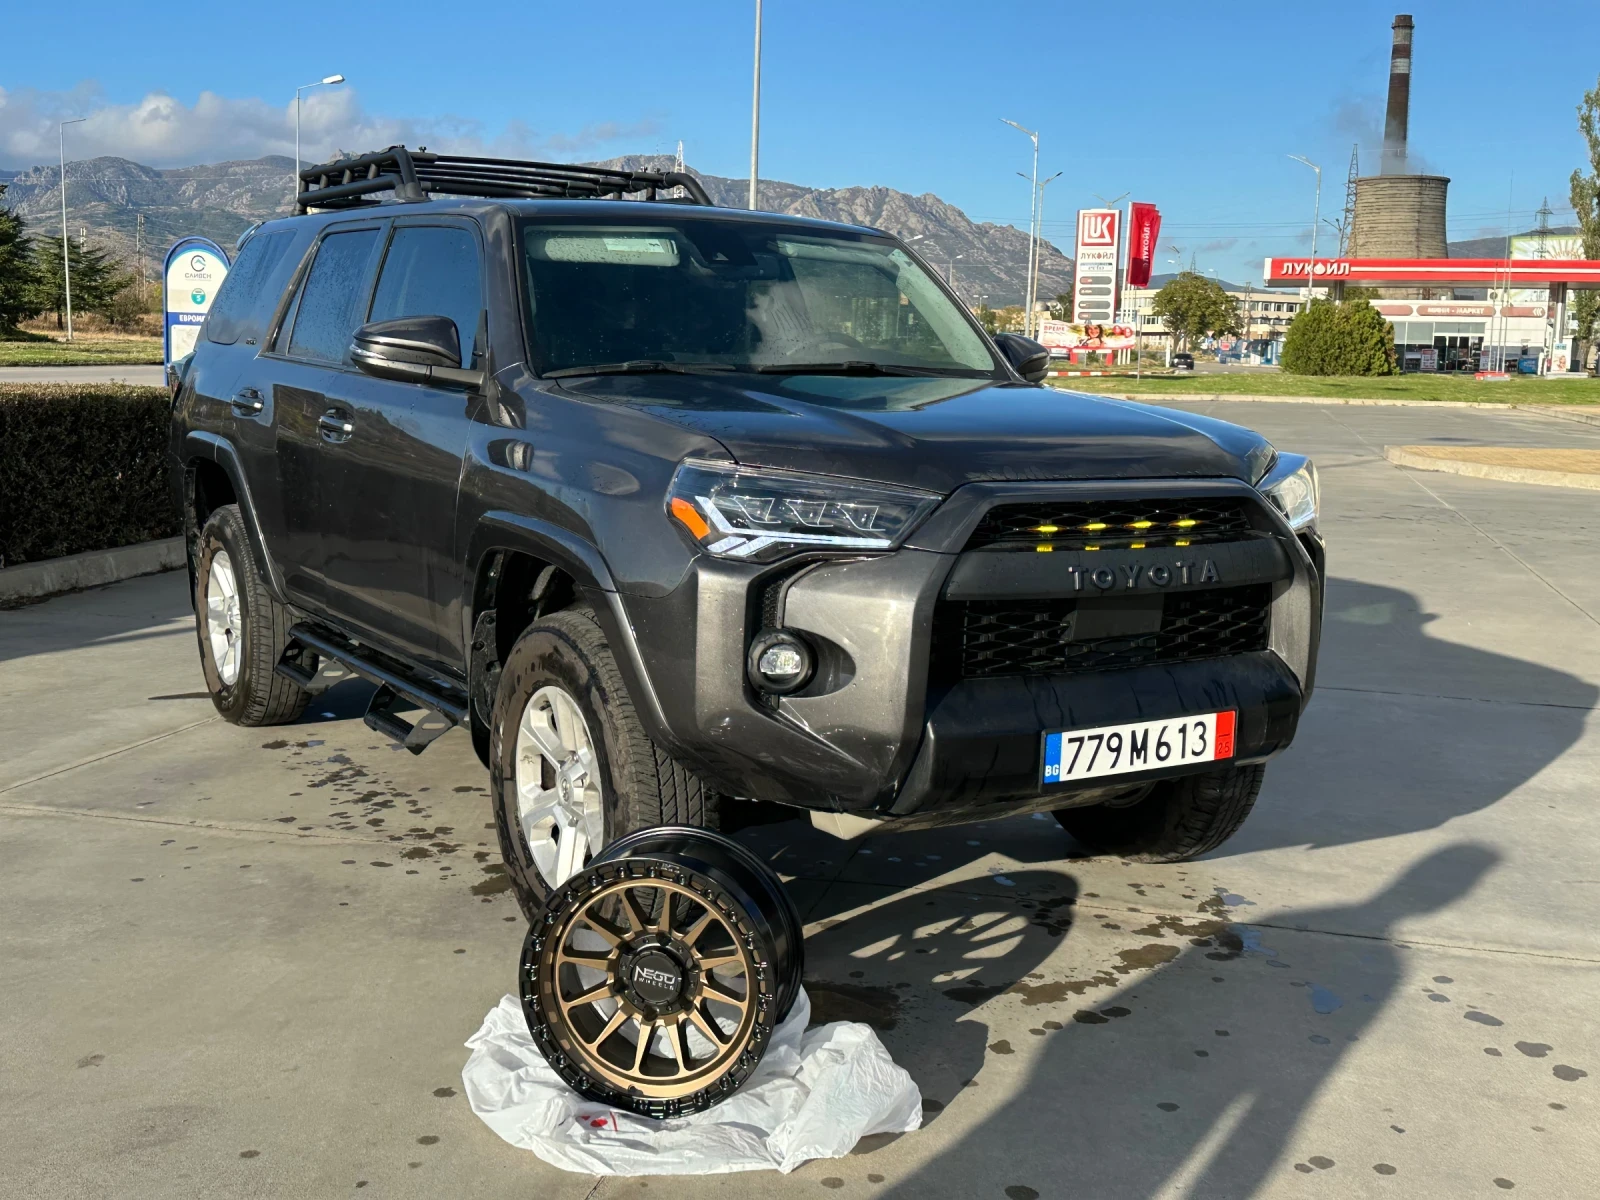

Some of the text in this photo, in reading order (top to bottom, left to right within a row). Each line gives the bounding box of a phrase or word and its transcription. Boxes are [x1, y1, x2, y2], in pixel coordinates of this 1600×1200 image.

[1281, 259, 1350, 275] ЛУКОЙЛ
[1068, 560, 1222, 591] TOYOTA
[1045, 764, 1060, 777] BG
[1218, 742, 1231, 754] 25
